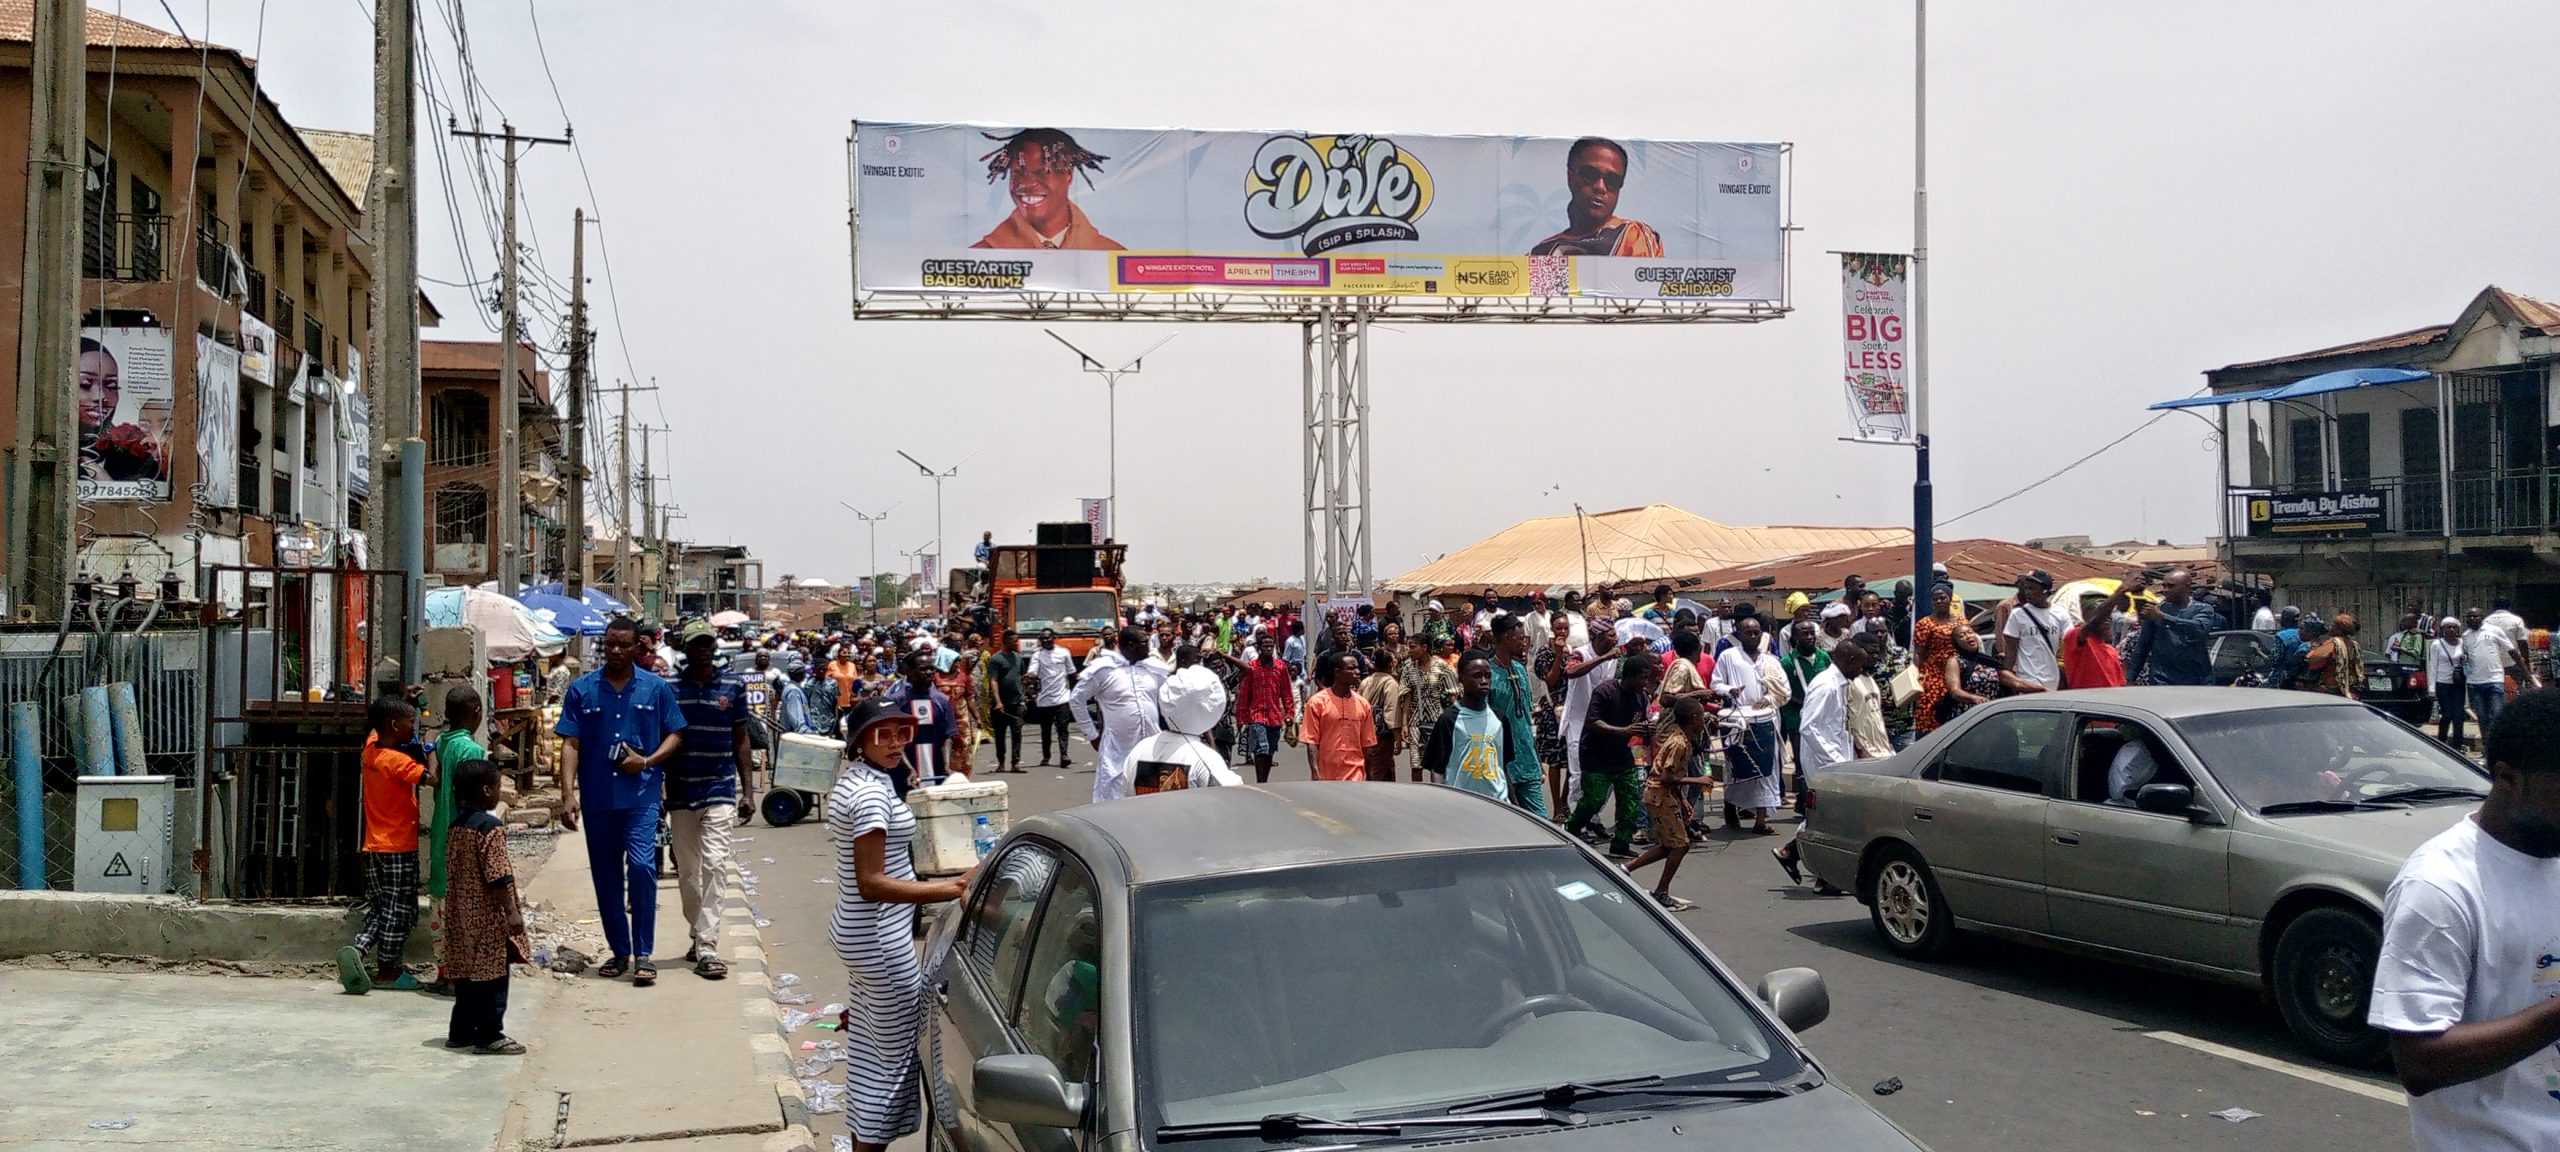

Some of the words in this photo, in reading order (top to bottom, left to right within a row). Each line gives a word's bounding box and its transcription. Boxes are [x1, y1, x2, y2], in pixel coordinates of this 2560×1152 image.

[1246, 137, 1421, 236] Dive
[1318, 234, 1342, 251] (SIP
[1356, 227, 1407, 240] SPLASH)
[923, 260, 975, 274] GUEST
[977, 262, 1032, 275] ARTIST
[1227, 268, 1251, 276] APRIL
[1488, 269, 1517, 279] EARLY
[1635, 267, 1683, 281] GUEST
[1685, 268, 1736, 281] ARTIST
[924, 274, 1023, 288] BADBOYTIMZ
[1488, 278, 1510, 286] BIRD
[1659, 283, 1732, 296] ASHIDAPO
[1855, 305, 1895, 315] Celebrate
[1847, 314, 1902, 342] BIG
[1862, 341, 1888, 351] Spend
[1848, 351, 1902, 370] LESS
[2030, 625, 2058, 636] DR
[1462, 746, 1498, 780] 40
